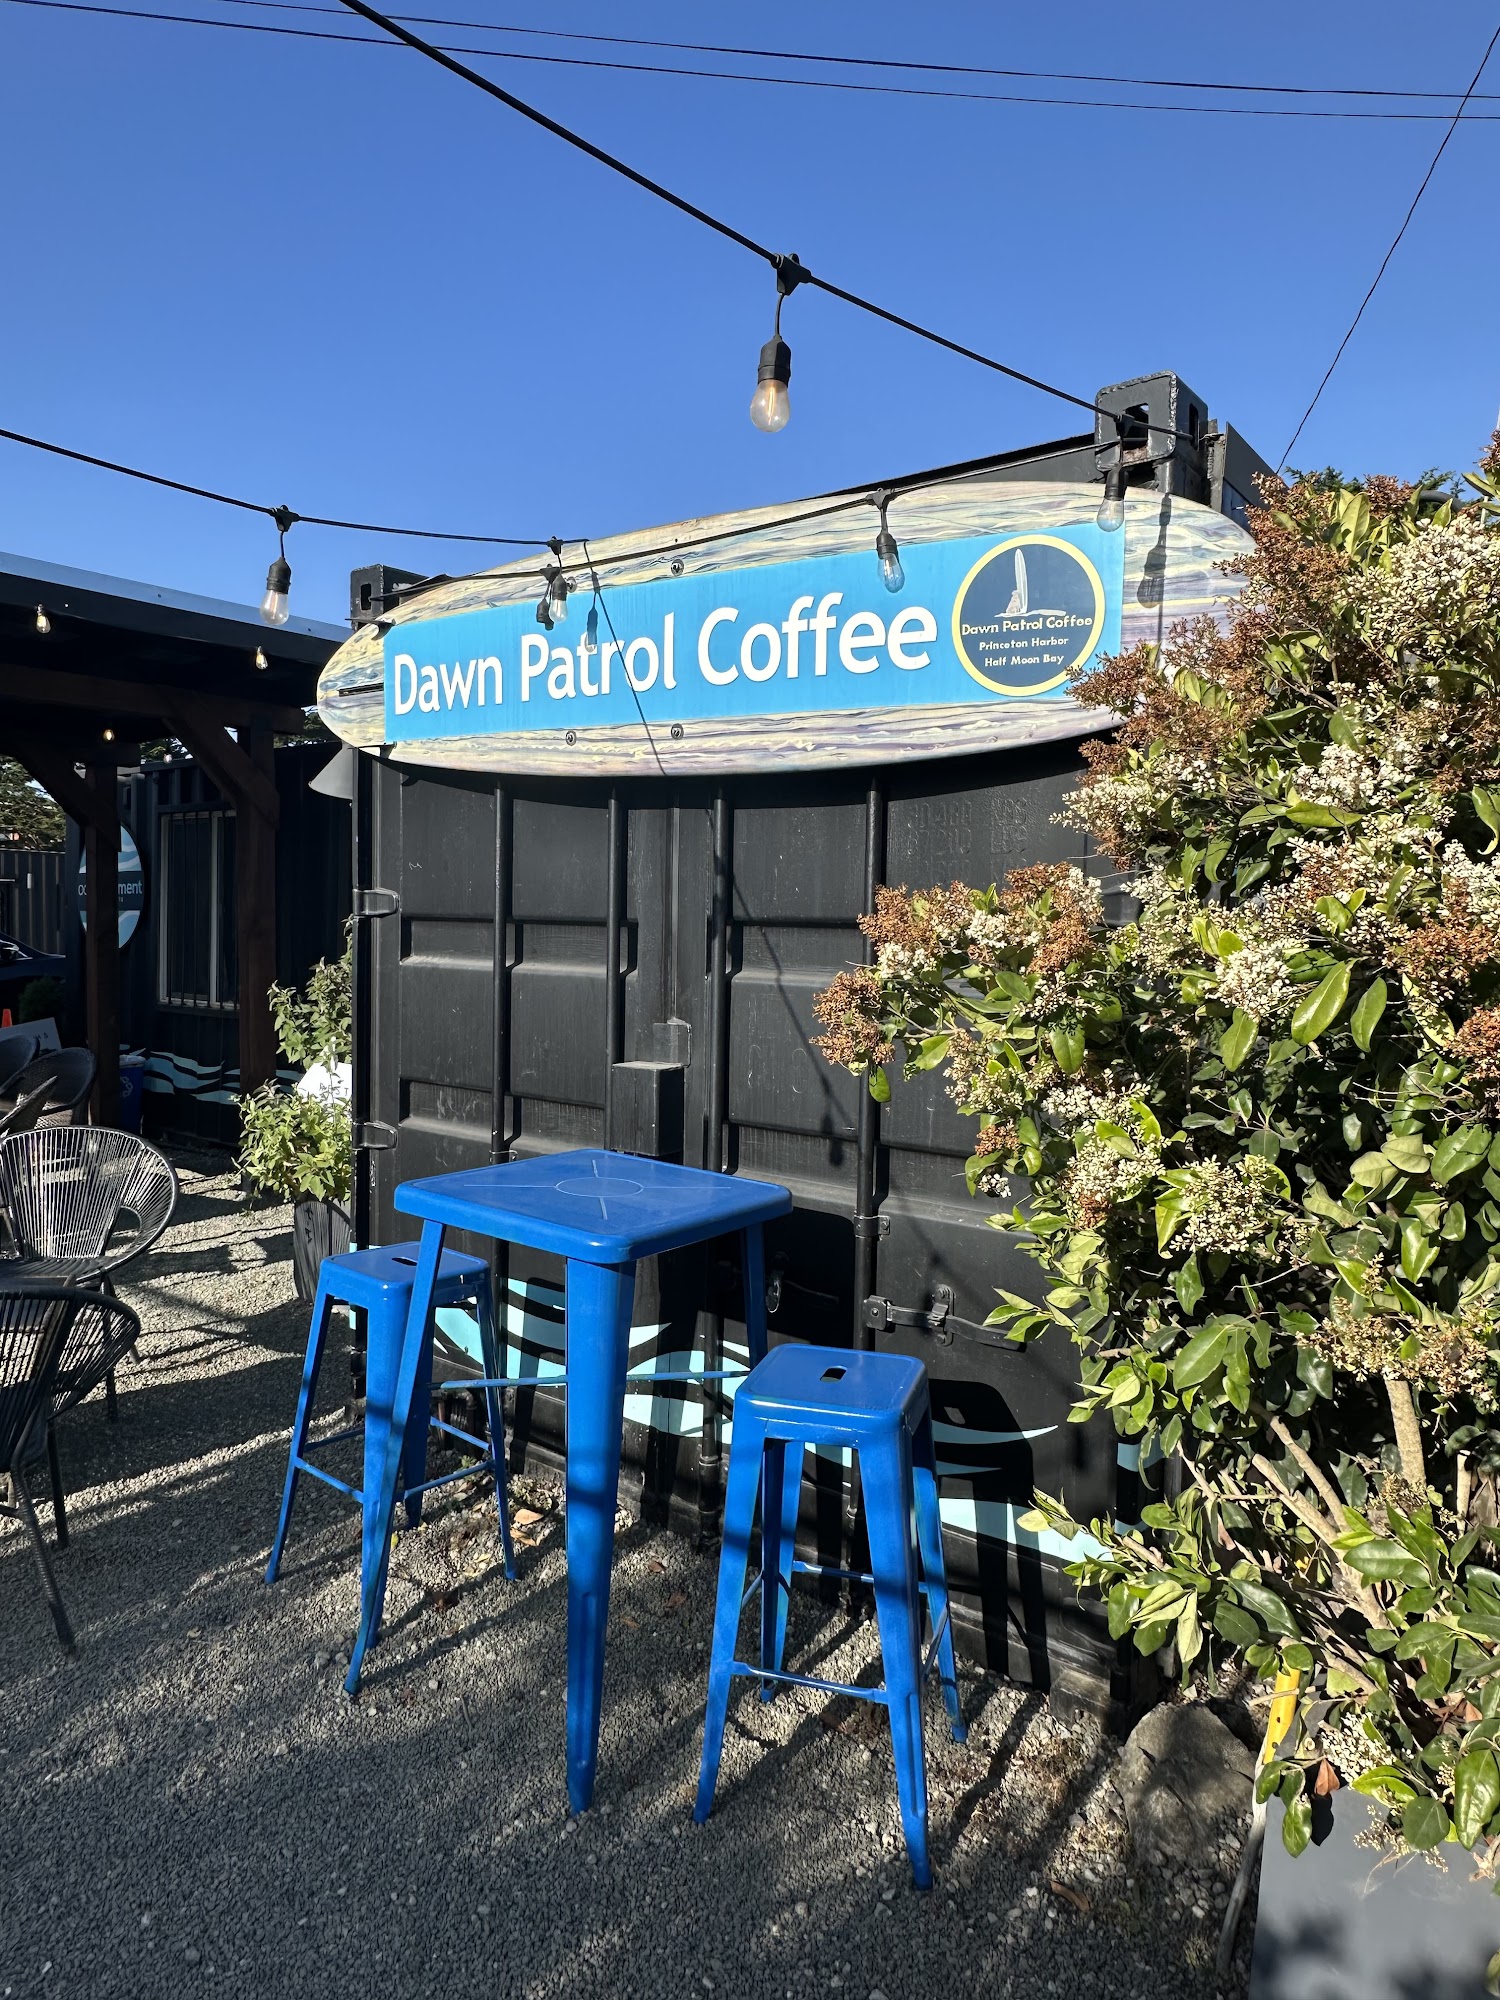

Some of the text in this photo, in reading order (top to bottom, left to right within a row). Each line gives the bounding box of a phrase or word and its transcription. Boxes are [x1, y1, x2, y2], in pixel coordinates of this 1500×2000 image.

[962, 615, 1093, 636] Dawn Patrol Coffee
[979, 636, 1069, 651] Princeton Harbor
[394, 592, 938, 715] Dawn Patrol Coffee
[984, 654, 1064, 667] Half Moon Bay
